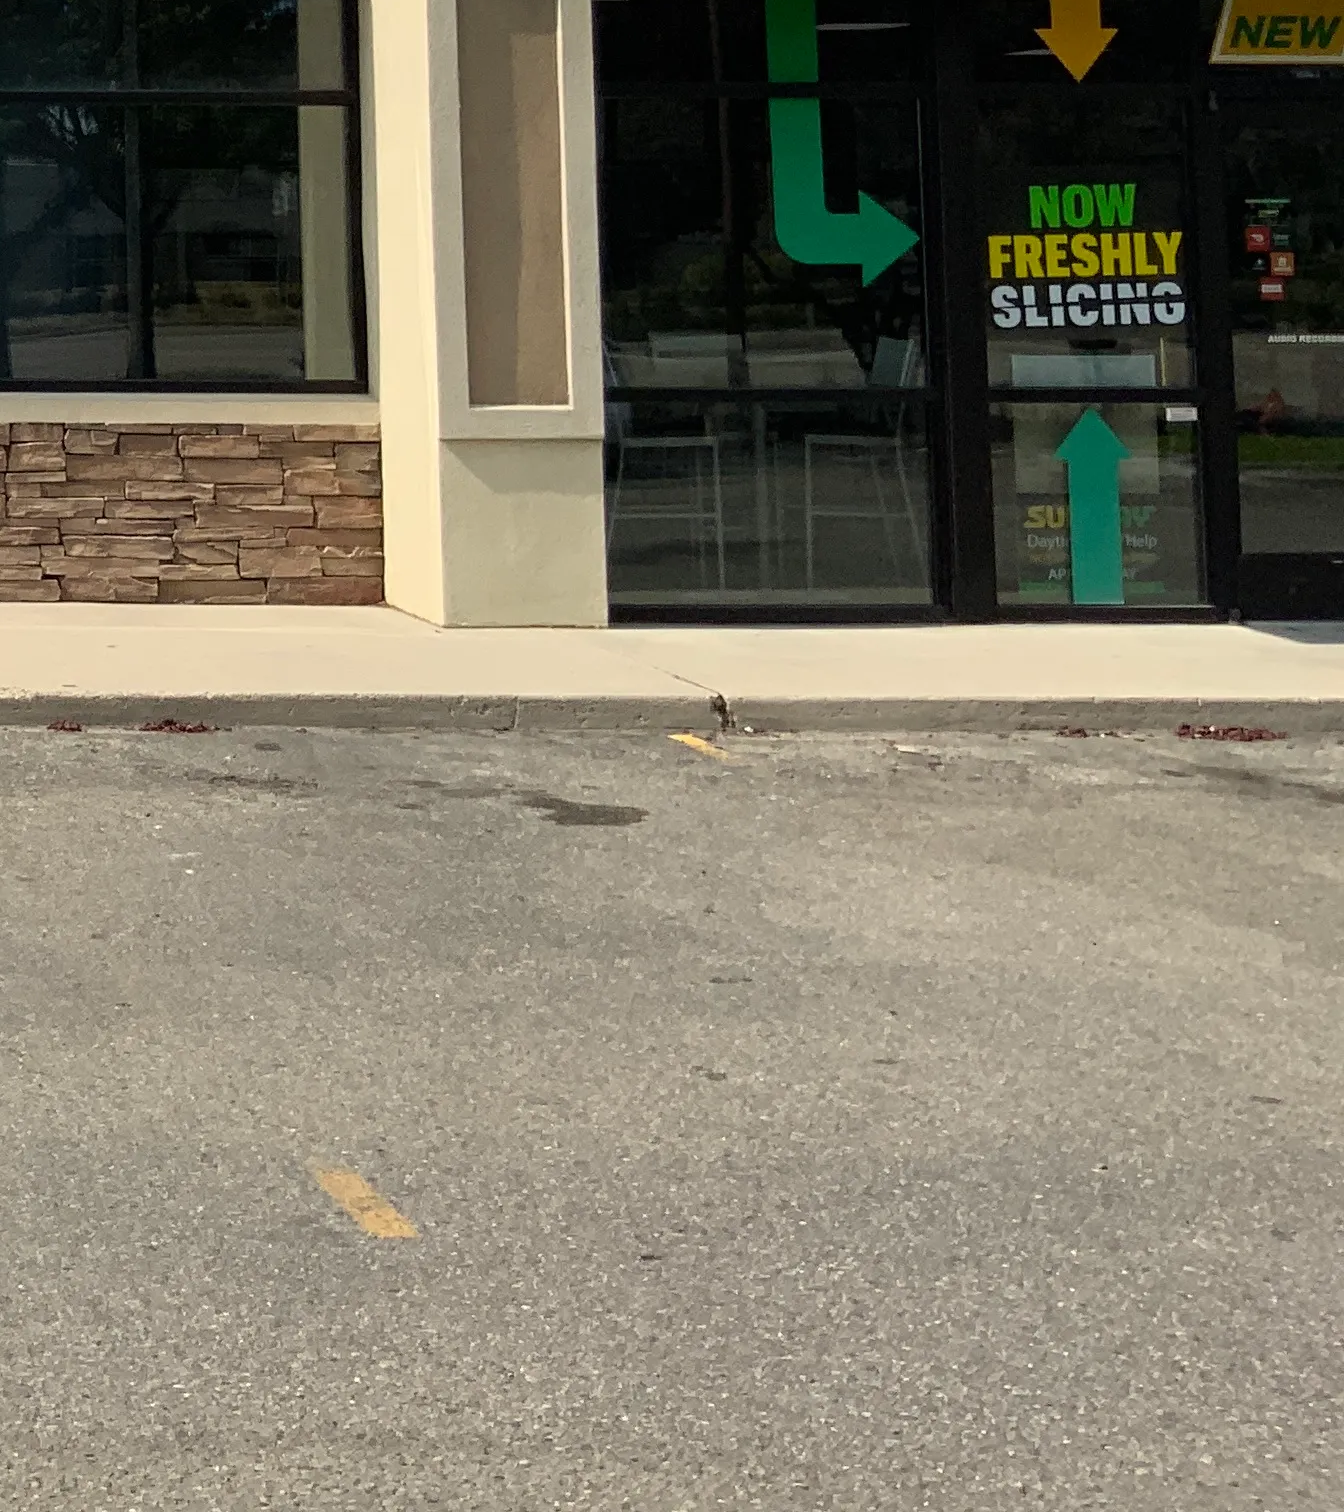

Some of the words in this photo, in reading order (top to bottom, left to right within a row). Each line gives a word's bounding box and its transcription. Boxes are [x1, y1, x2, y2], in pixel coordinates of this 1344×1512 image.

[1229, 15, 1342, 49] NEW
[1028, 183, 1137, 229] NOW
[988, 231, 1183, 278] FRESHLY
[991, 282, 1186, 329] SLICING
